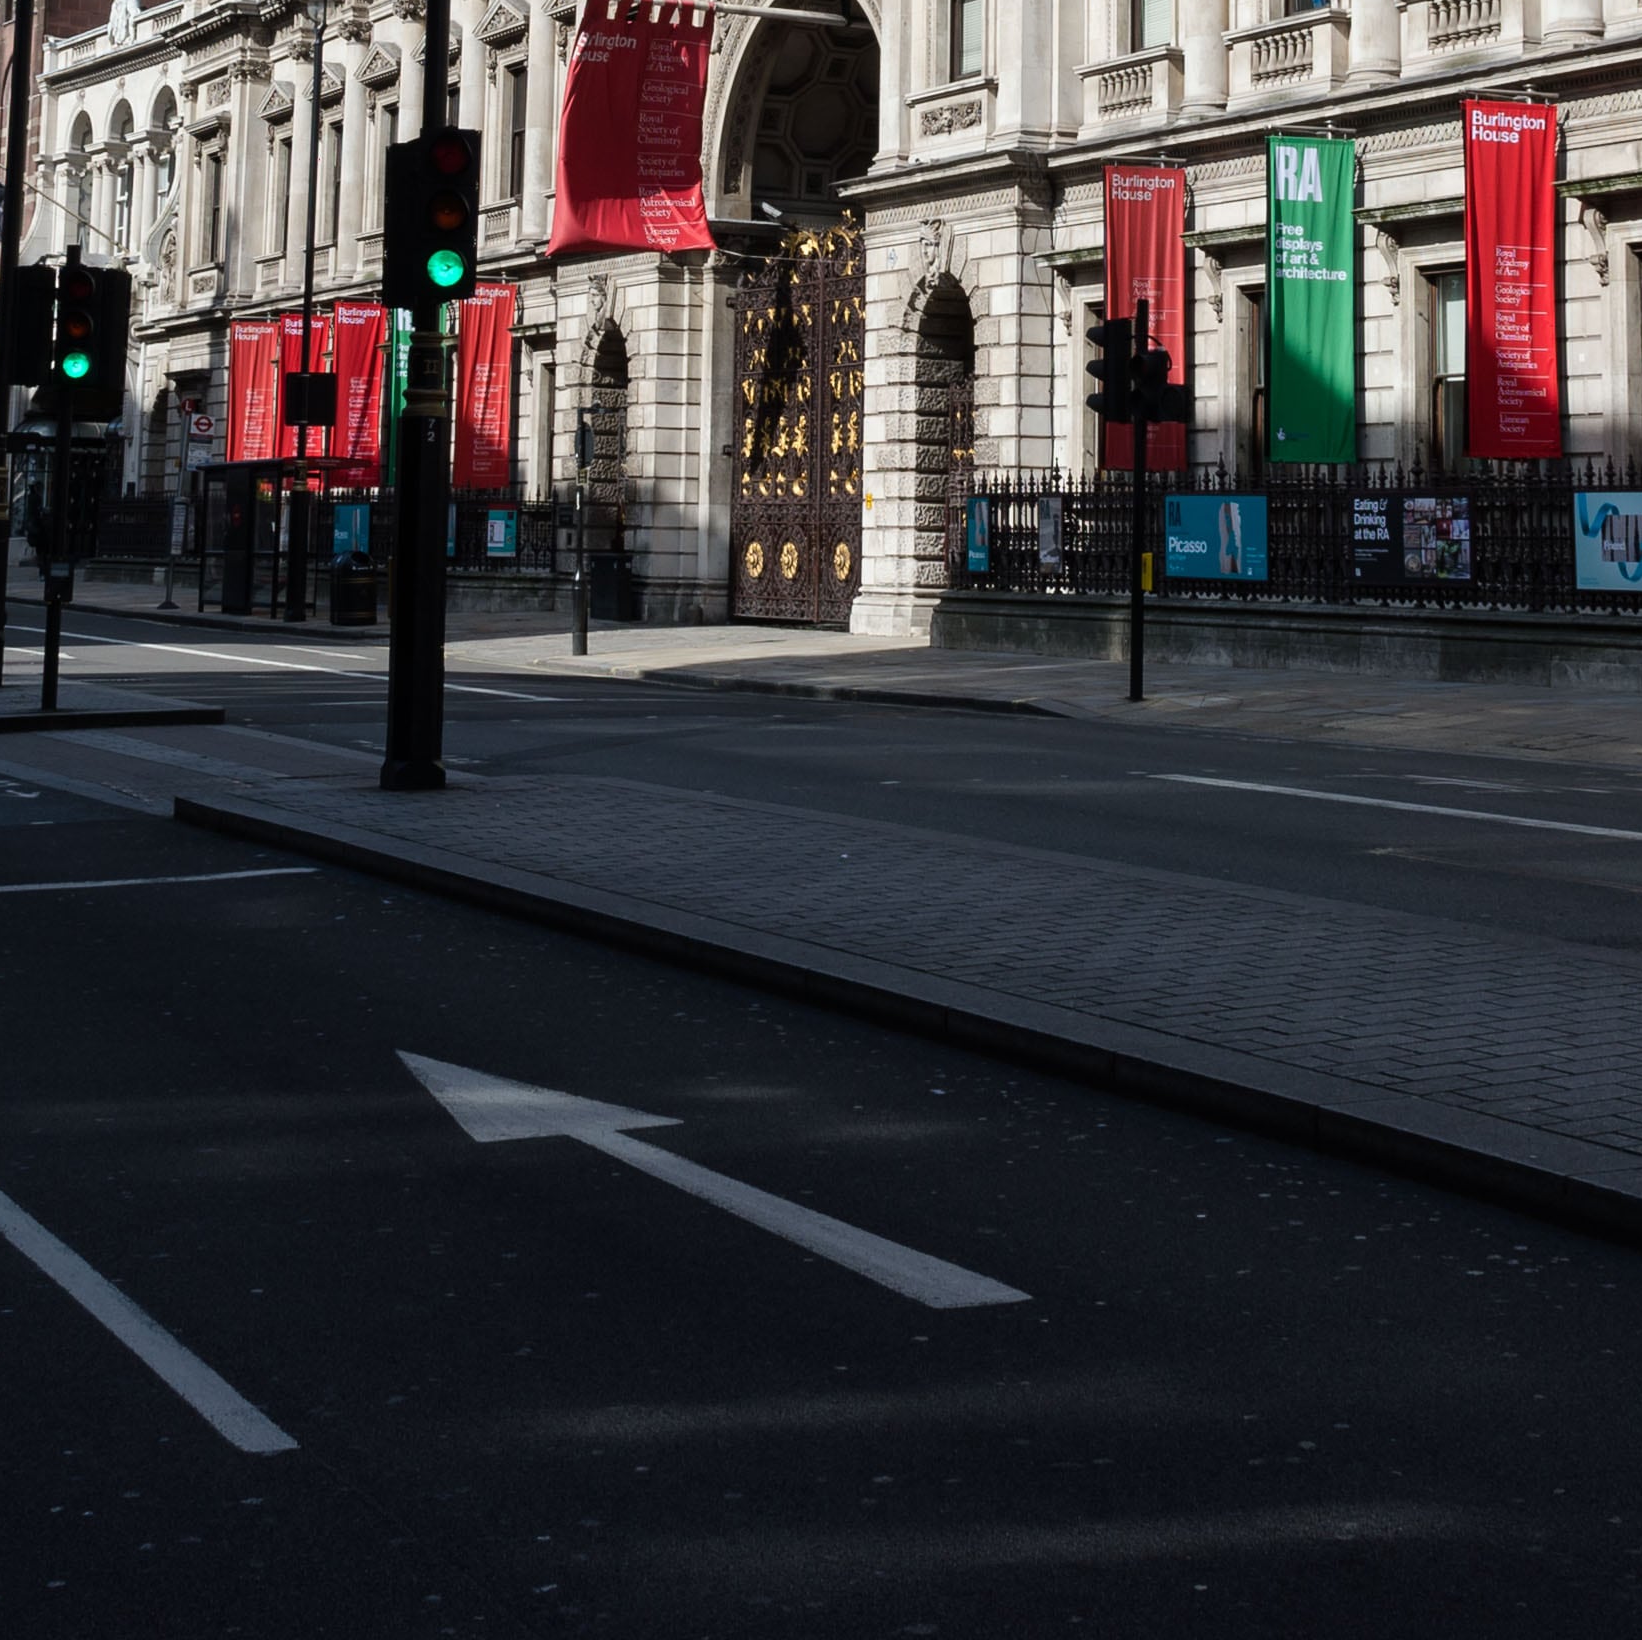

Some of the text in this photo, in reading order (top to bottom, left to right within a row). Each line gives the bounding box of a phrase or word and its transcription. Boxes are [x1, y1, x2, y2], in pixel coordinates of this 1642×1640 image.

[639, 112, 664, 124] Royal
[1472, 110, 1545, 131] Burlington
[638, 123, 668, 138] Society
[1472, 125, 1519, 143] House
[637, 135, 681, 148] Chemistry
[637, 154, 666, 169] Society
[637, 166, 686, 180] Antiquaries
[1276, 145, 1323, 202] RA
[1112, 174, 1175, 191] Burlington
[1112, 187, 1152, 201] House
[640, 207, 672, 219] Society
[1276, 222, 1304, 237] Free
[1276, 236, 1323, 253] displays
[1276, 250, 1320, 266] of art &
[1496, 247, 1517, 260] Royal
[1496, 258, 1530, 270] Academy
[1276, 266, 1348, 281] architecture
[1503, 266, 1520, 276] Arts
[474, 287, 510, 299] rlington
[1495, 294, 1521, 307] Society
[338, 307, 381, 319] Burlington
[1496, 312, 1516, 325] Royal
[338, 315, 366, 325] House
[235, 325, 275, 335] Burlington
[1496, 322, 1520, 333] Society
[1495, 331, 1533, 344] Chemistry
[1495, 349, 1520, 361] Society
[1497, 359, 1538, 371] Antiquaries
[1497, 376, 1518, 389] Royal
[1497, 387, 1546, 397] Astronomical
[1497, 396, 1523, 408] Society
[1500, 423, 1526, 436] Society
[1354, 498, 1388, 513] Eating &
[1354, 512, 1387, 528] Drinking
[1354, 527, 1390, 541] at the RA
[1168, 536, 1208, 554] Picasso
